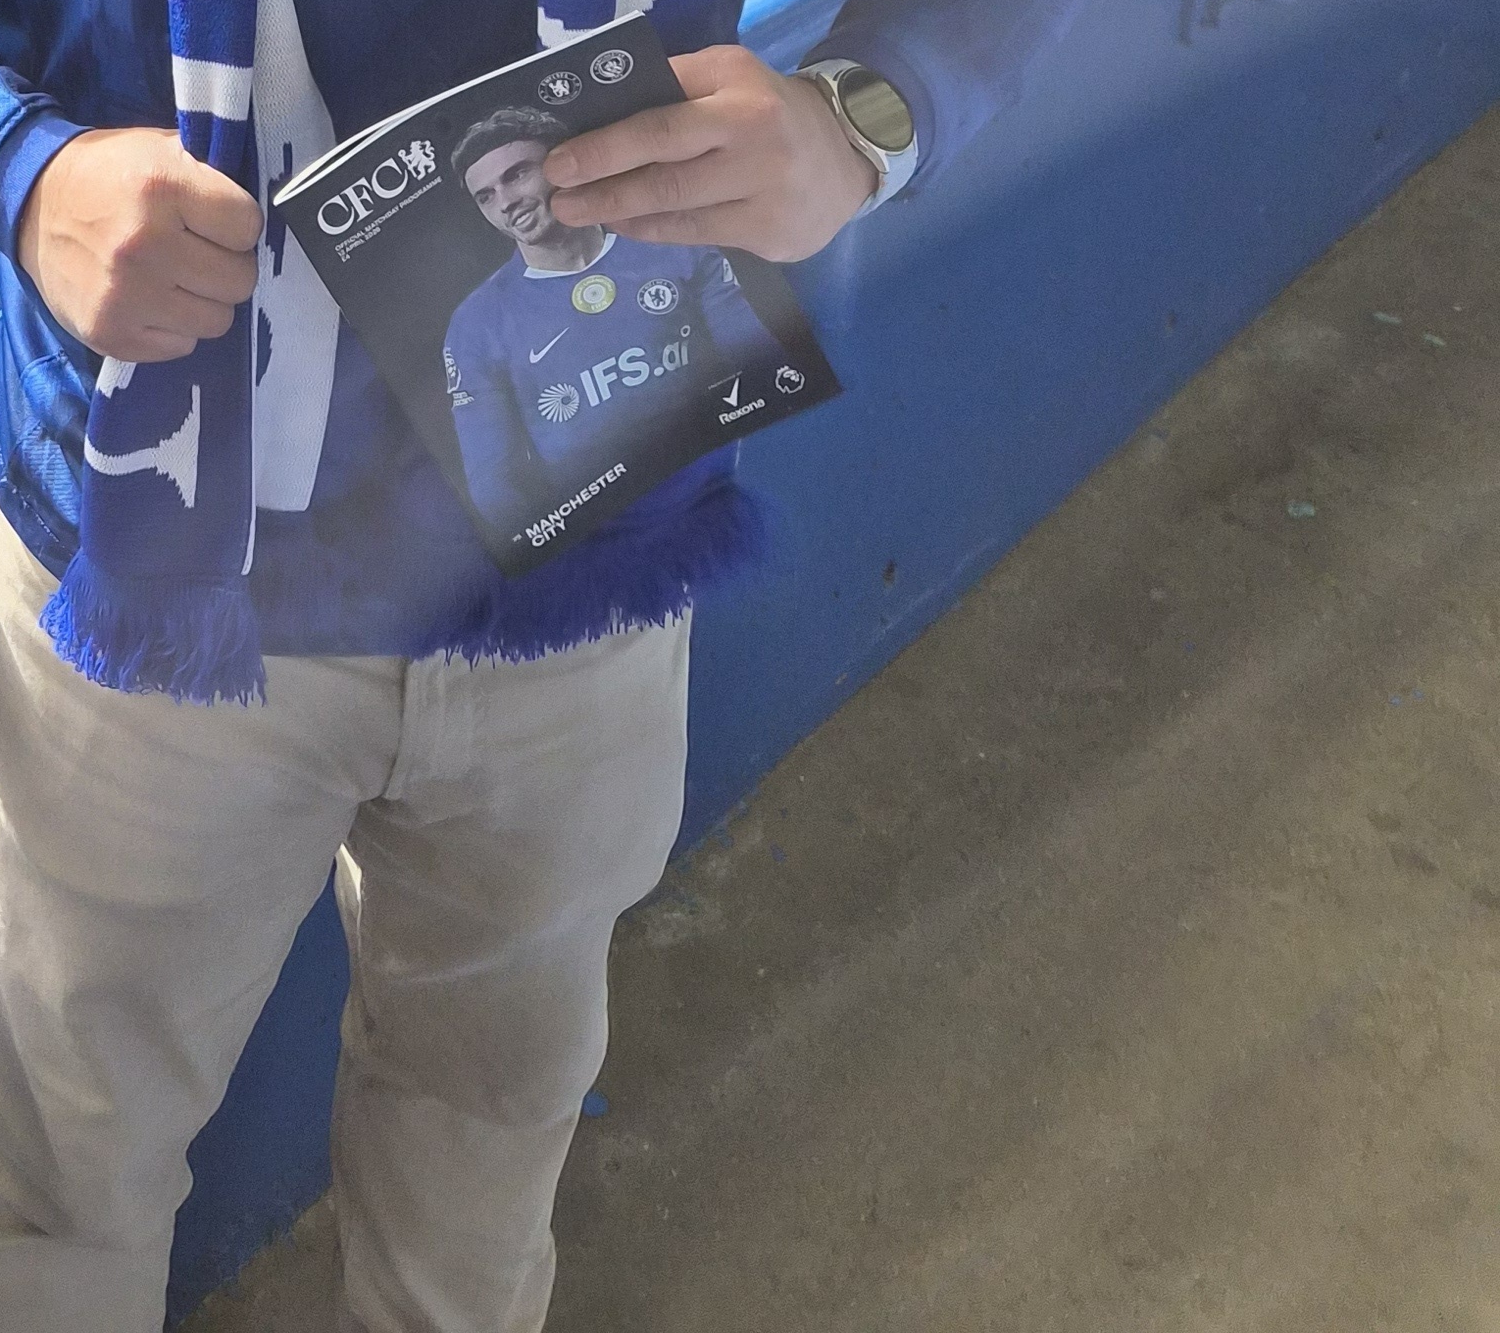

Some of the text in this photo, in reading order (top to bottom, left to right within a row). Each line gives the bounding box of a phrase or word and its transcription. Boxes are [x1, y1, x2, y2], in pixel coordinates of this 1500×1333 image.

[317, 157, 409, 235] CFC
[335, 175, 443, 252] OFFICIAL MATCHDAY PROGRAMME
[579, 324, 692, 408] IFS.ai
[718, 398, 766, 426] Rexona
[525, 462, 628, 540] MANCHESTER
[531, 518, 566, 548] CITY
